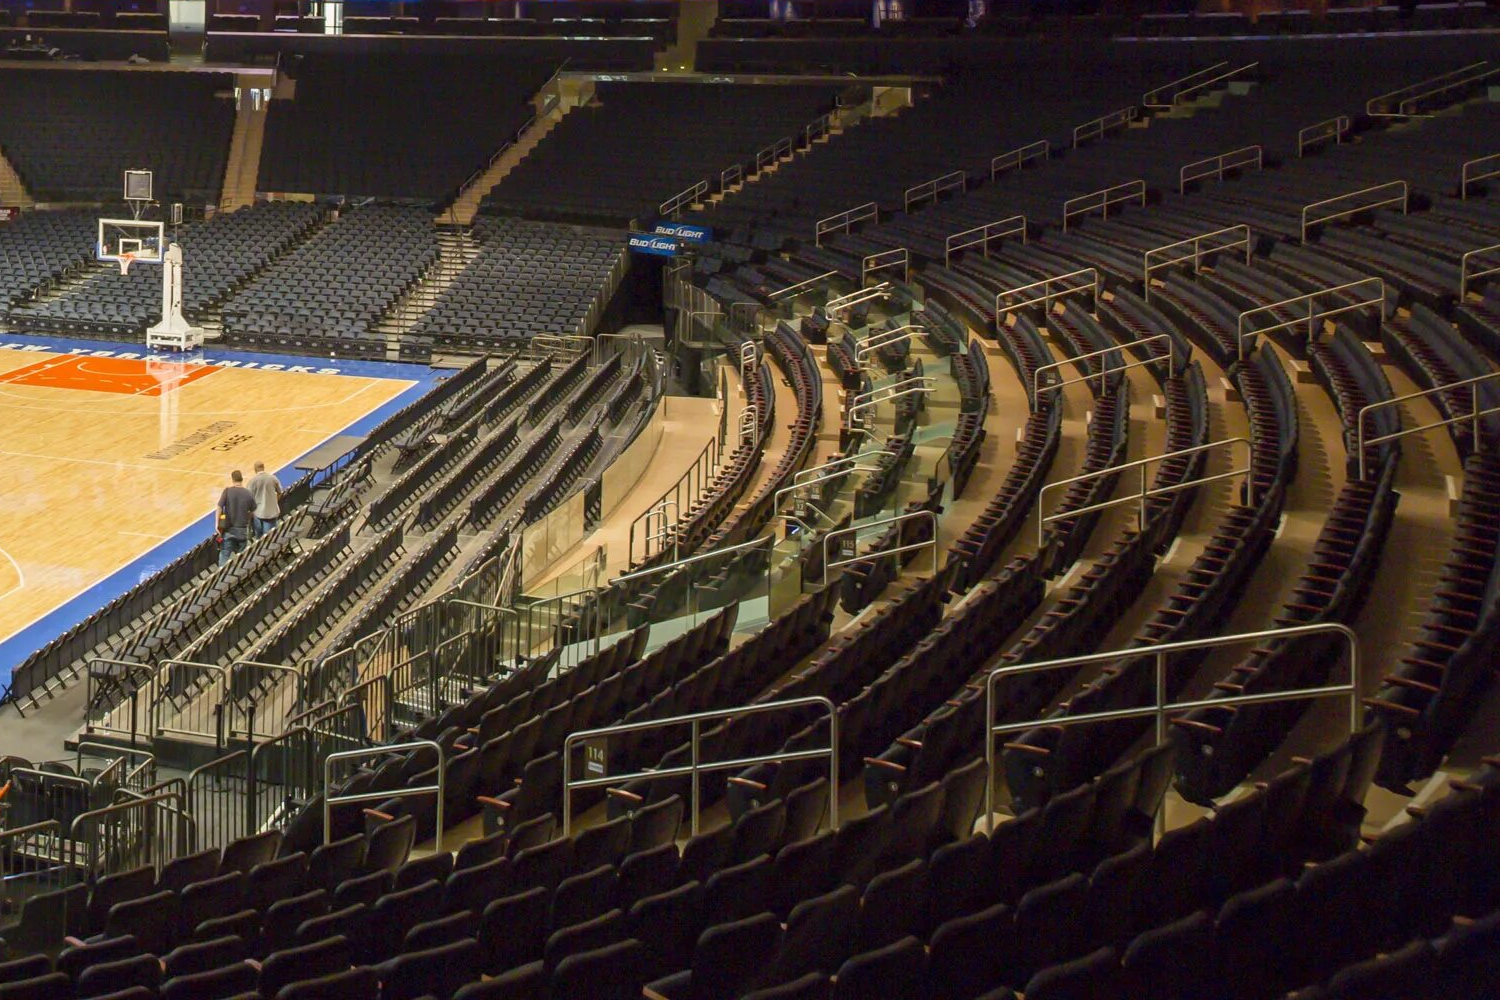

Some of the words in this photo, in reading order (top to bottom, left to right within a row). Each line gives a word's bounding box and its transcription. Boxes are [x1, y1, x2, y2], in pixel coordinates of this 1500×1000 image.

[656, 226, 674, 234] BUD
[677, 229, 704, 238] LIGHT
[629, 239, 648, 247] BUD
[652, 242, 676, 250] LIGHT
[188, 358, 341, 375] KNICKS
[589, 747, 603, 762] 114
